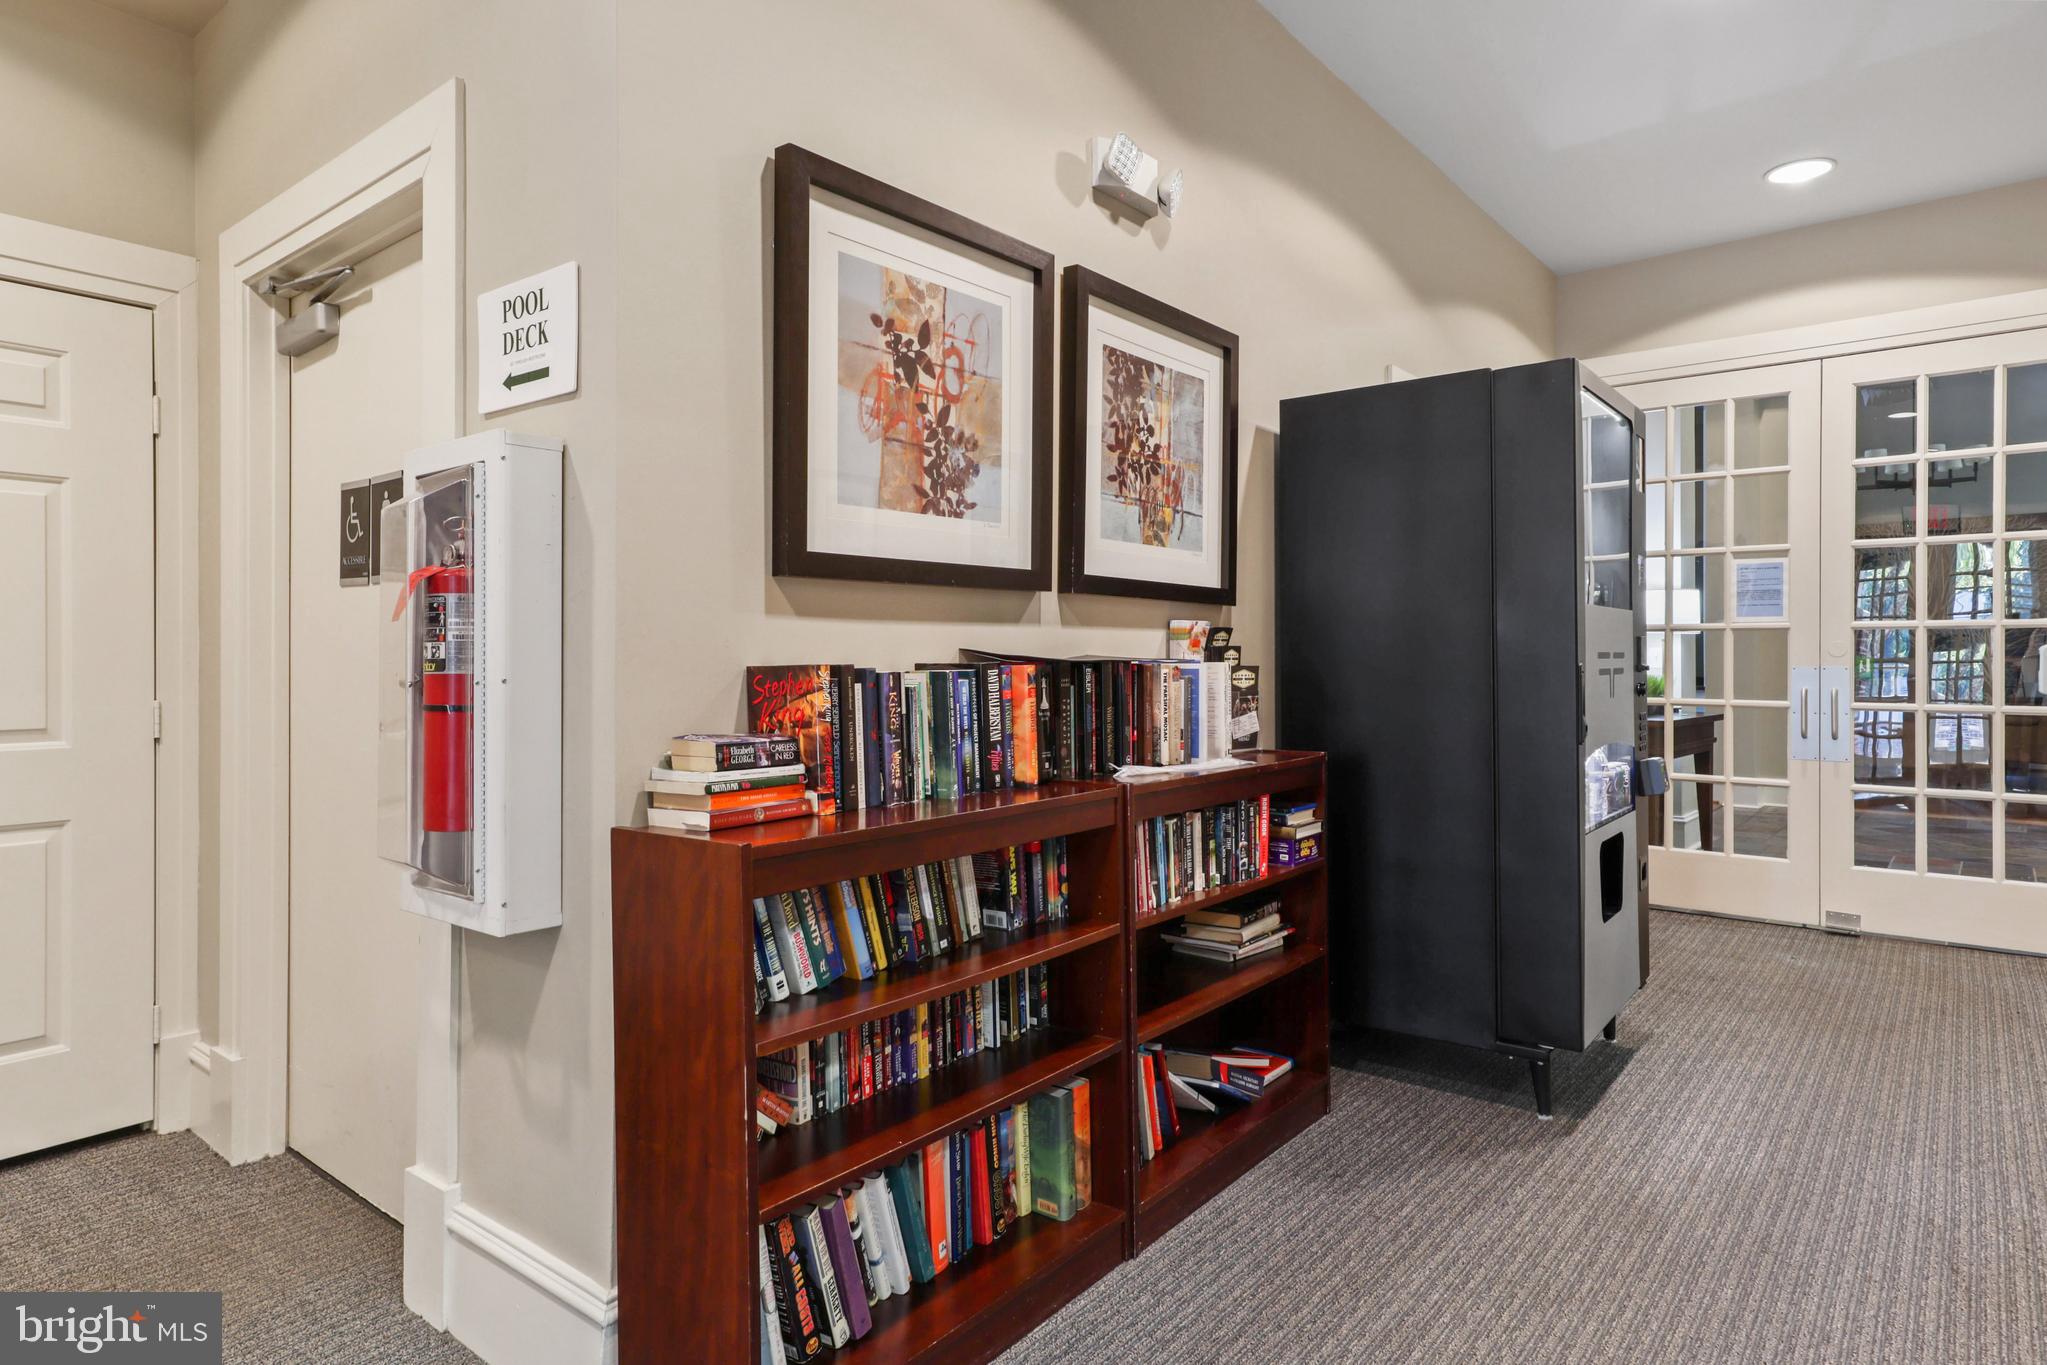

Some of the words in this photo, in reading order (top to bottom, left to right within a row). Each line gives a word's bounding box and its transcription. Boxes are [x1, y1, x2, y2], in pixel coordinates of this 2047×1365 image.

[502, 287, 550, 324] POOL
[502, 319, 549, 356] DECK
[752, 671, 815, 706] Stephen
[818, 669, 831, 704] Stephen
[831, 683, 840, 706] JERRY
[987, 669, 999, 692] DAVID
[759, 699, 806, 737] King
[820, 703, 832, 722] King
[833, 706, 841, 739] SEINFELD
[889, 692, 898, 729] KING
[973, 713, 978, 721] OF
[988, 692, 1002, 742] HALBERSTAM
[1004, 702, 1012, 734] HARRIS
[730, 745, 755, 756] Elizabeth
[730, 754, 755, 764] GEORGE
[770, 743, 797, 752] CARELESS
[783, 752, 794, 760] RED
[988, 750, 1003, 772] Fifties
[907, 880, 921, 922] PATTERSON
[935, 905, 943, 926] VISION
[762, 924, 774, 937] THE
[783, 901, 799, 929] Dowd
[793, 931, 812, 979] BUSHWORLD
[804, 905, 822, 946] HINTS
[990, 1114, 998, 1137] OHN
[991, 1138, 999, 1169] RINGO
[811, 1211, 826, 1244] MARCH
[819, 1245, 831, 1259] OR
[822, 1259, 834, 1276] DIE
[791, 1263, 804, 1290] ALL
[795, 1288, 815, 1337] COSTS
[828, 1276, 844, 1324] GERAGHTY
